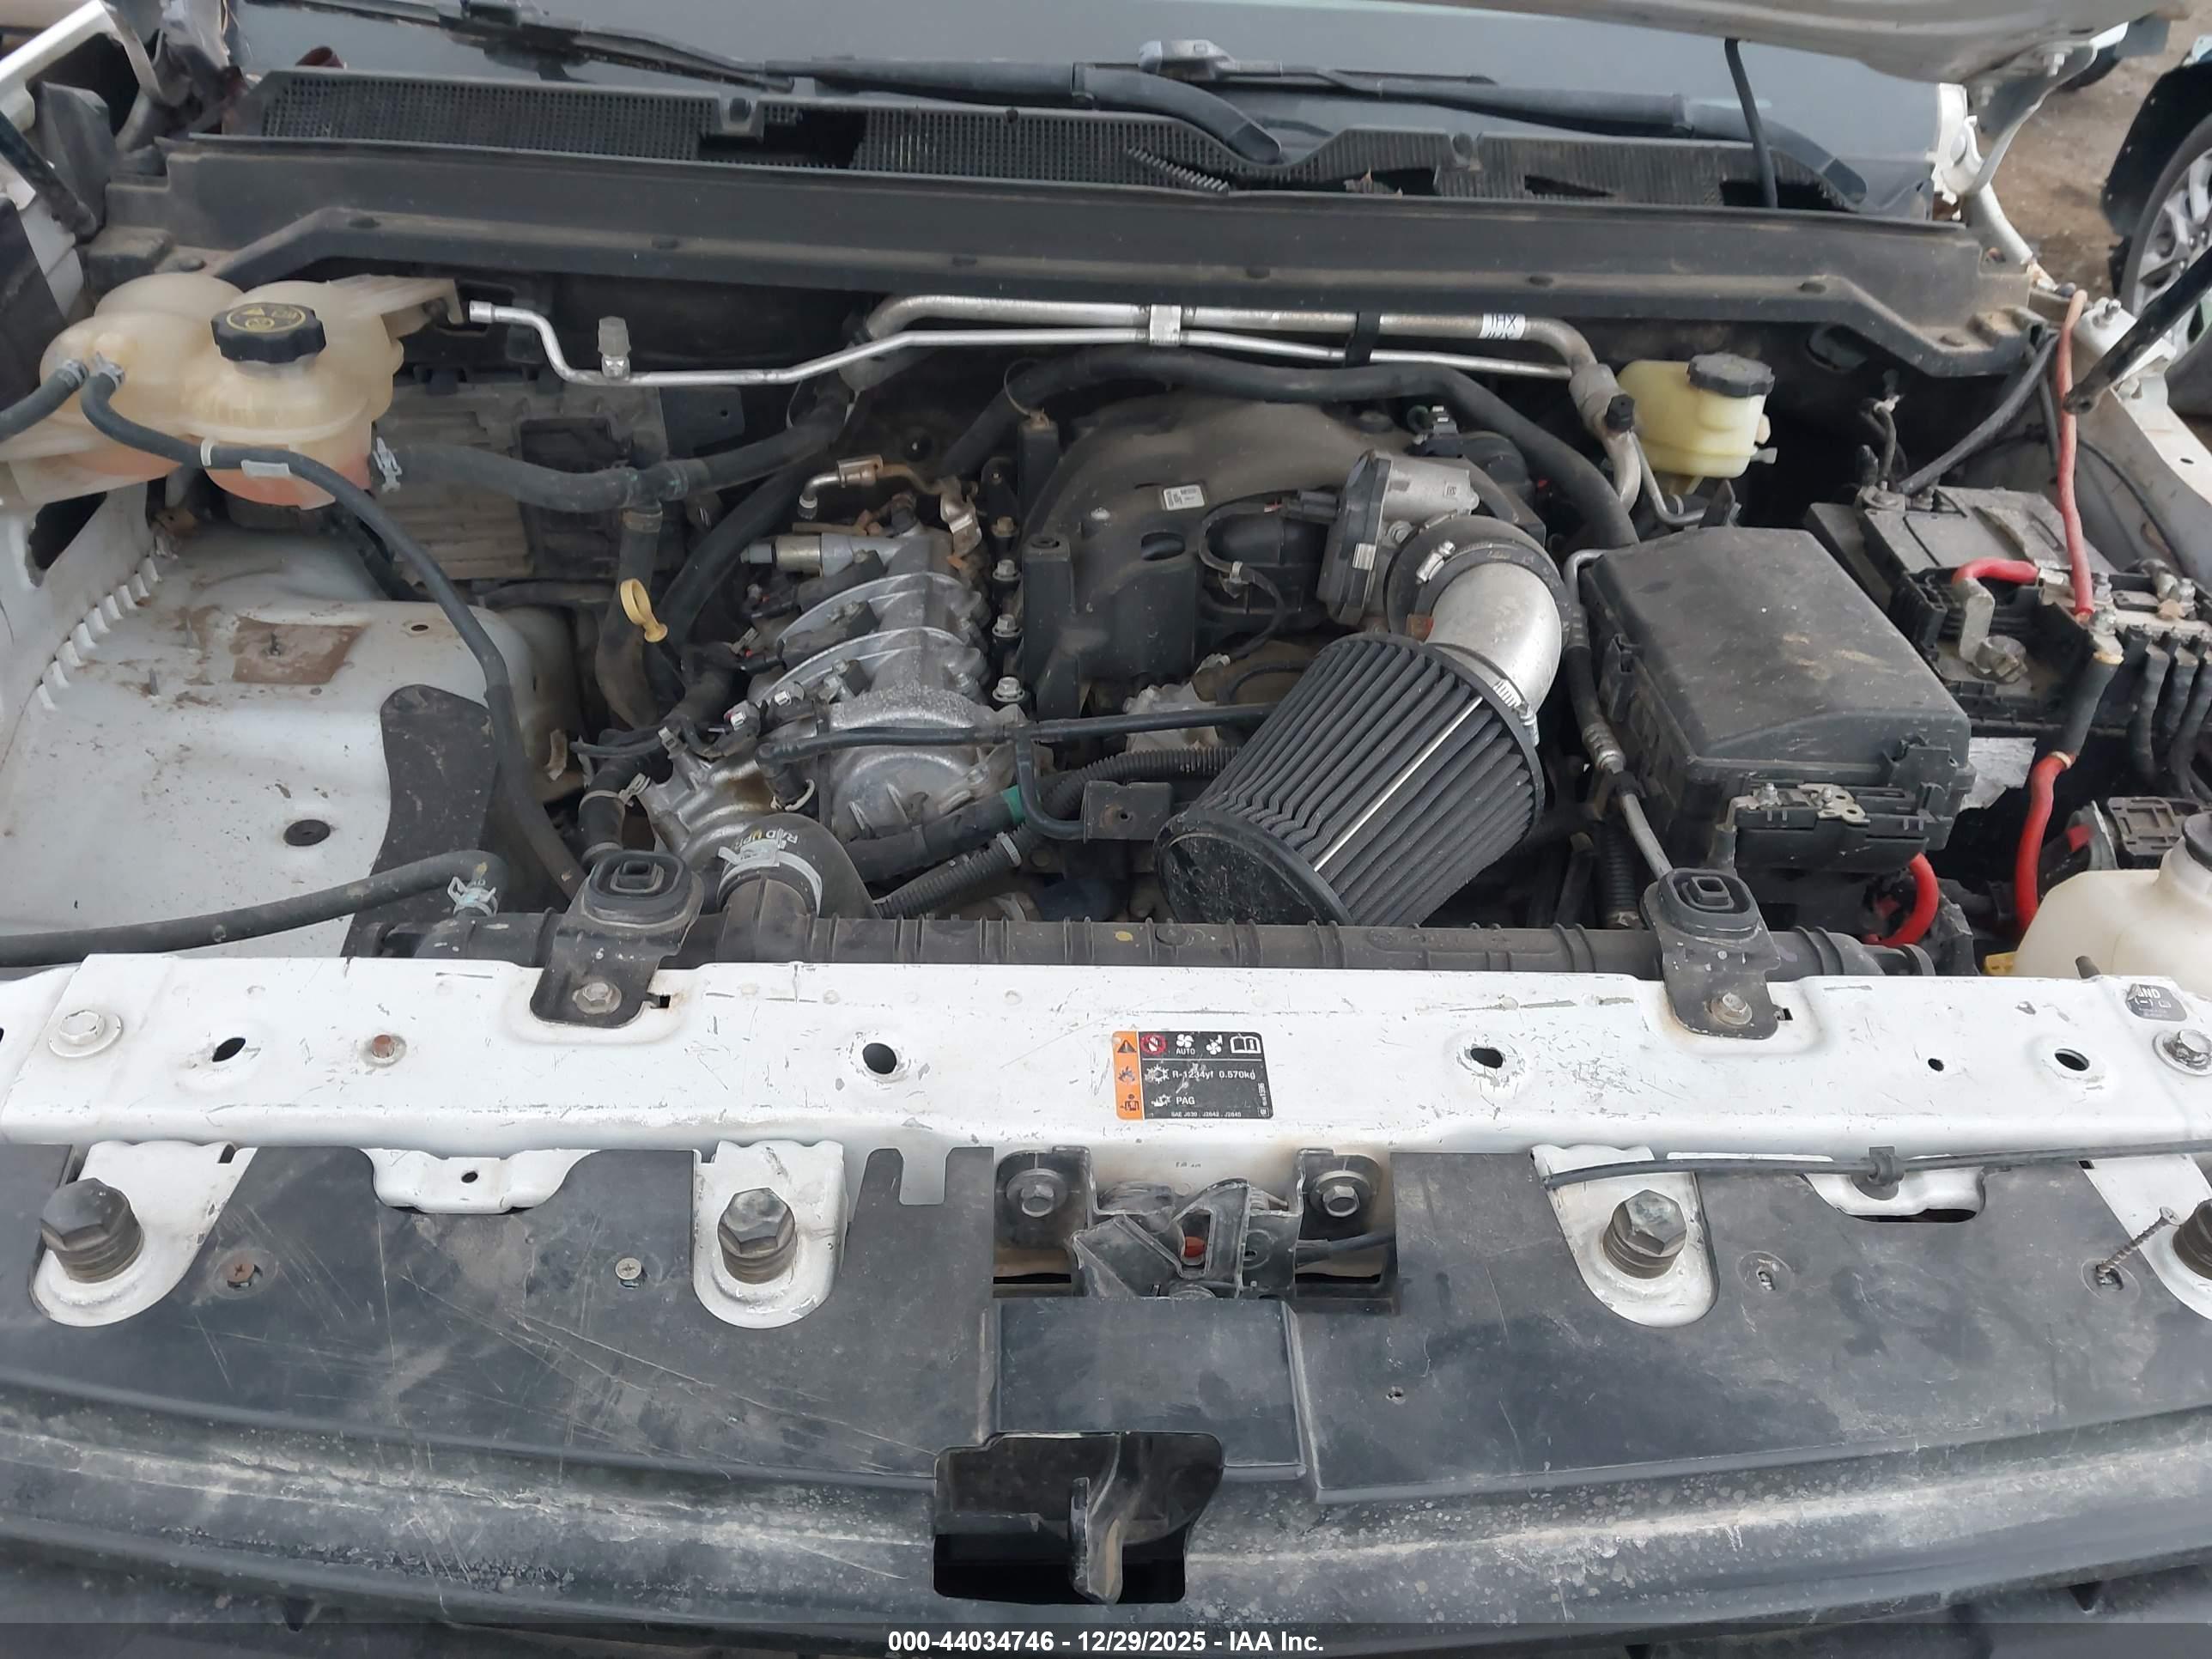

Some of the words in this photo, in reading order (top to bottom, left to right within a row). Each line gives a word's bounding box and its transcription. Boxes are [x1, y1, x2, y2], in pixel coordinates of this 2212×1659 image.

[1172, 1070, 1213, 1080] R-1234yf
[1218, 1070, 1256, 1080] 0.570kg
[1176, 1097, 1195, 1105] PAG
